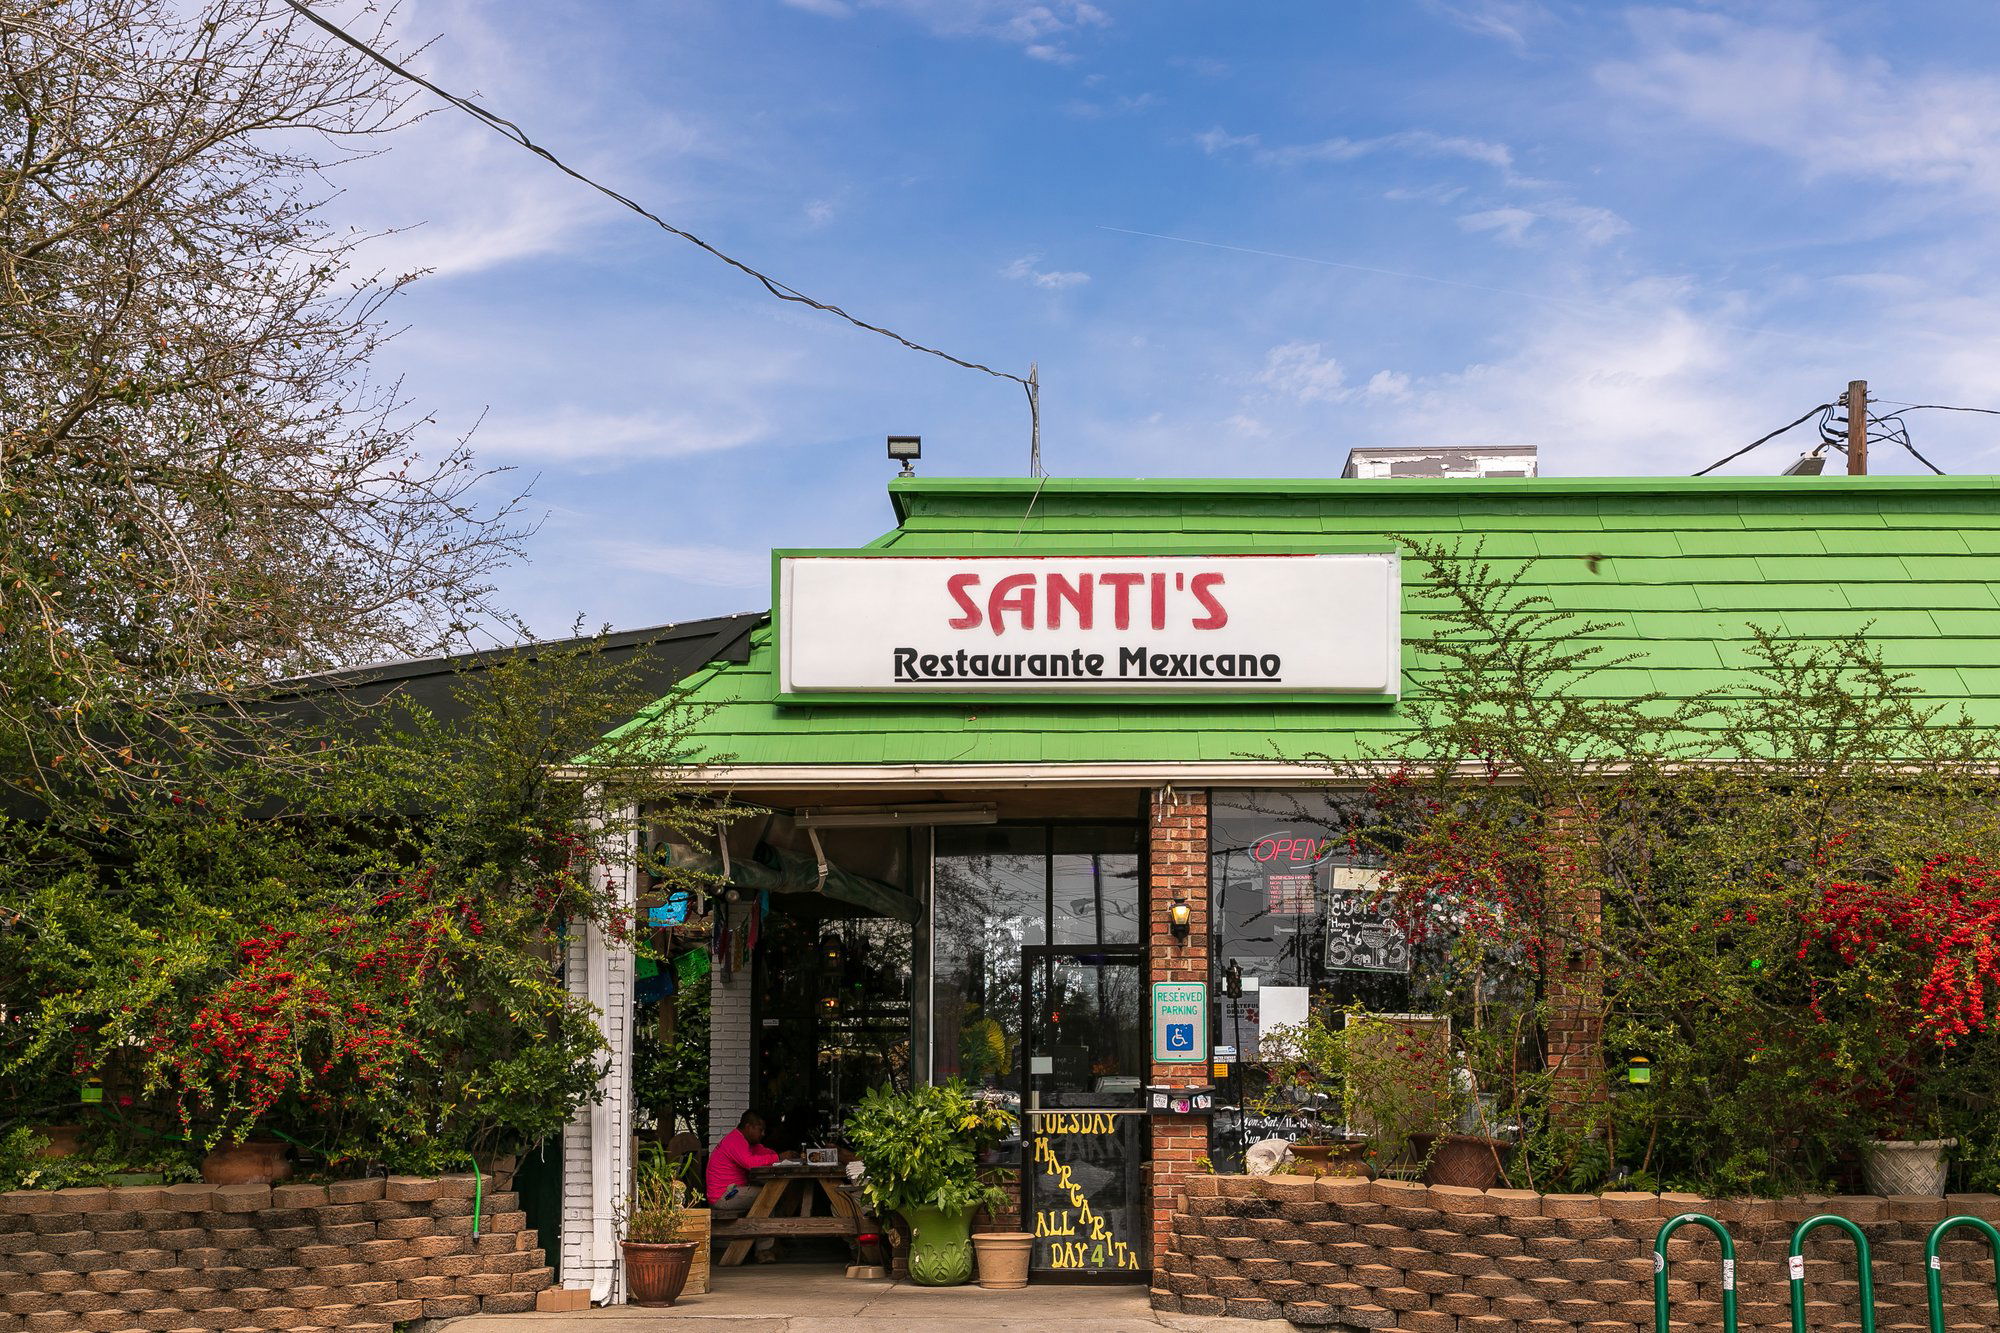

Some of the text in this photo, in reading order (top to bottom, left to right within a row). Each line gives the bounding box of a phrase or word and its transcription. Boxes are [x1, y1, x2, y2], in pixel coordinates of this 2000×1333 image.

[946, 571, 1229, 635] SANTI'S
[893, 646, 1282, 679] Restaurante Mexicano
[1254, 838, 1326, 862] OPEN
[1157, 991, 1203, 1002] RESERVED
[1161, 1005, 1198, 1015] PARKING
[1036, 1113, 1118, 1134] TUESDAY
[1035, 1210, 1075, 1238] ALL
[1051, 1241, 1105, 1269] DAY 4
